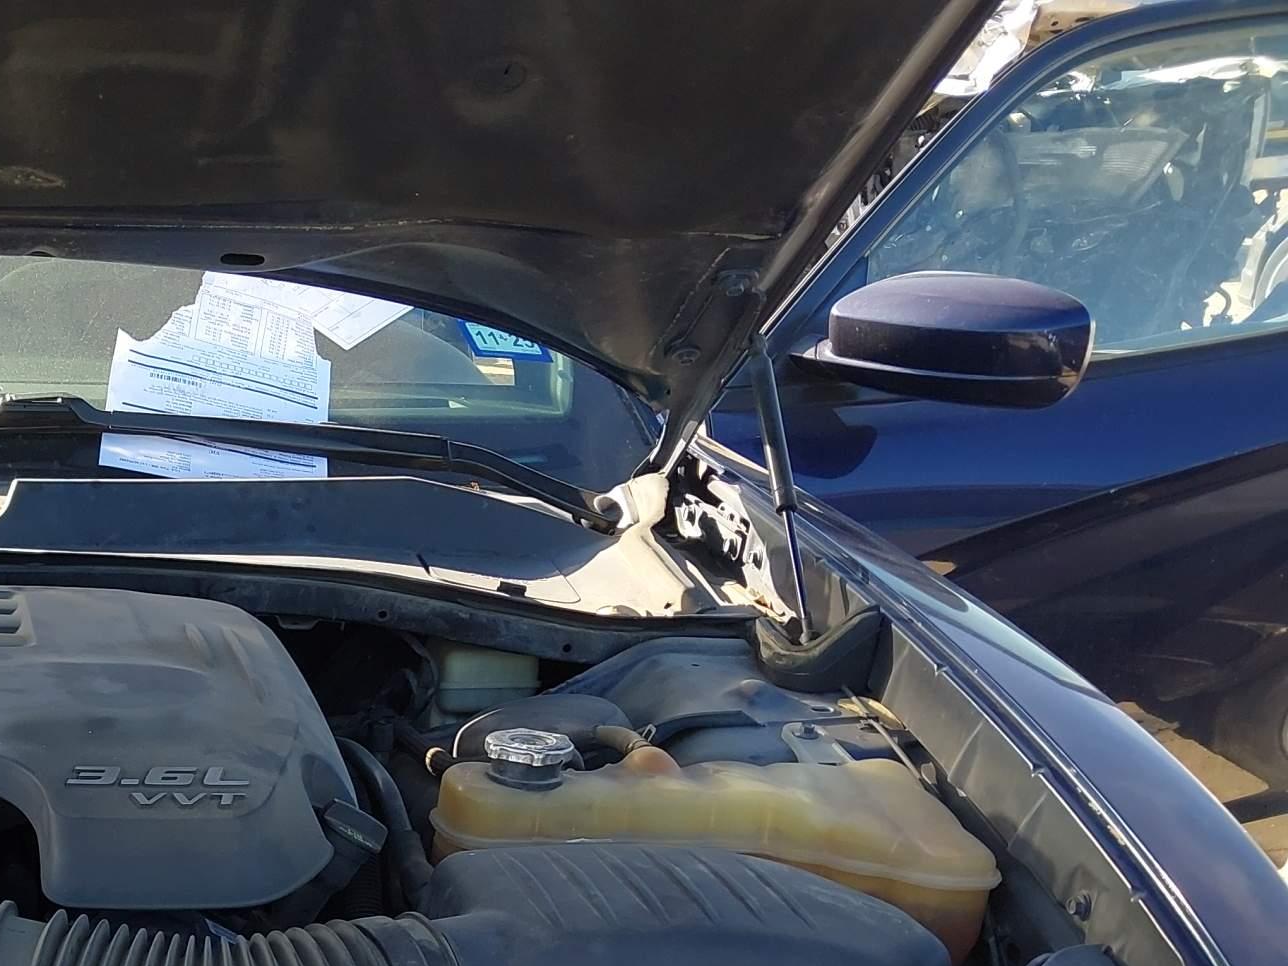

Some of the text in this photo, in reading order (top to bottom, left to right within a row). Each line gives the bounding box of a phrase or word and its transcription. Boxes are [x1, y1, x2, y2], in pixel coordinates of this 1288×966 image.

[475, 330, 500, 346] 11
[65, 765, 250, 787] 3.6L
[130, 791, 249, 807] VVT
